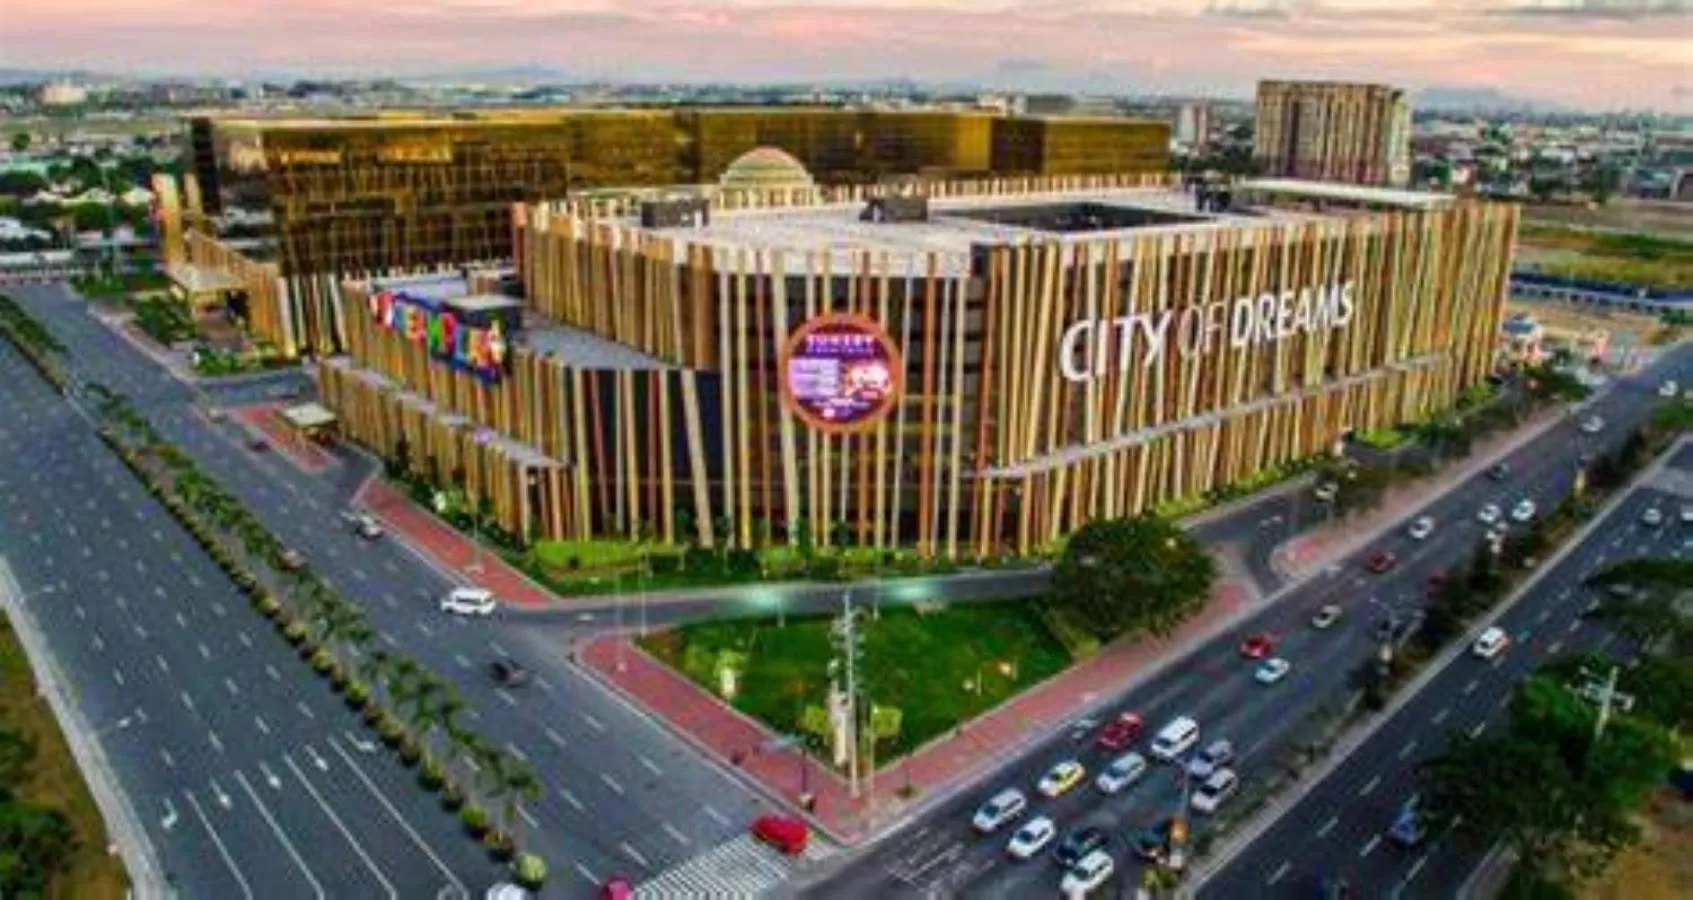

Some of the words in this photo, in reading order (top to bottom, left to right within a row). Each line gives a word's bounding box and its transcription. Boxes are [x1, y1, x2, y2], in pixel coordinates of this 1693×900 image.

[1060, 310, 1172, 382] CITY
[1177, 302, 1225, 360] OF
[1231, 281, 1355, 348] DREAMS
